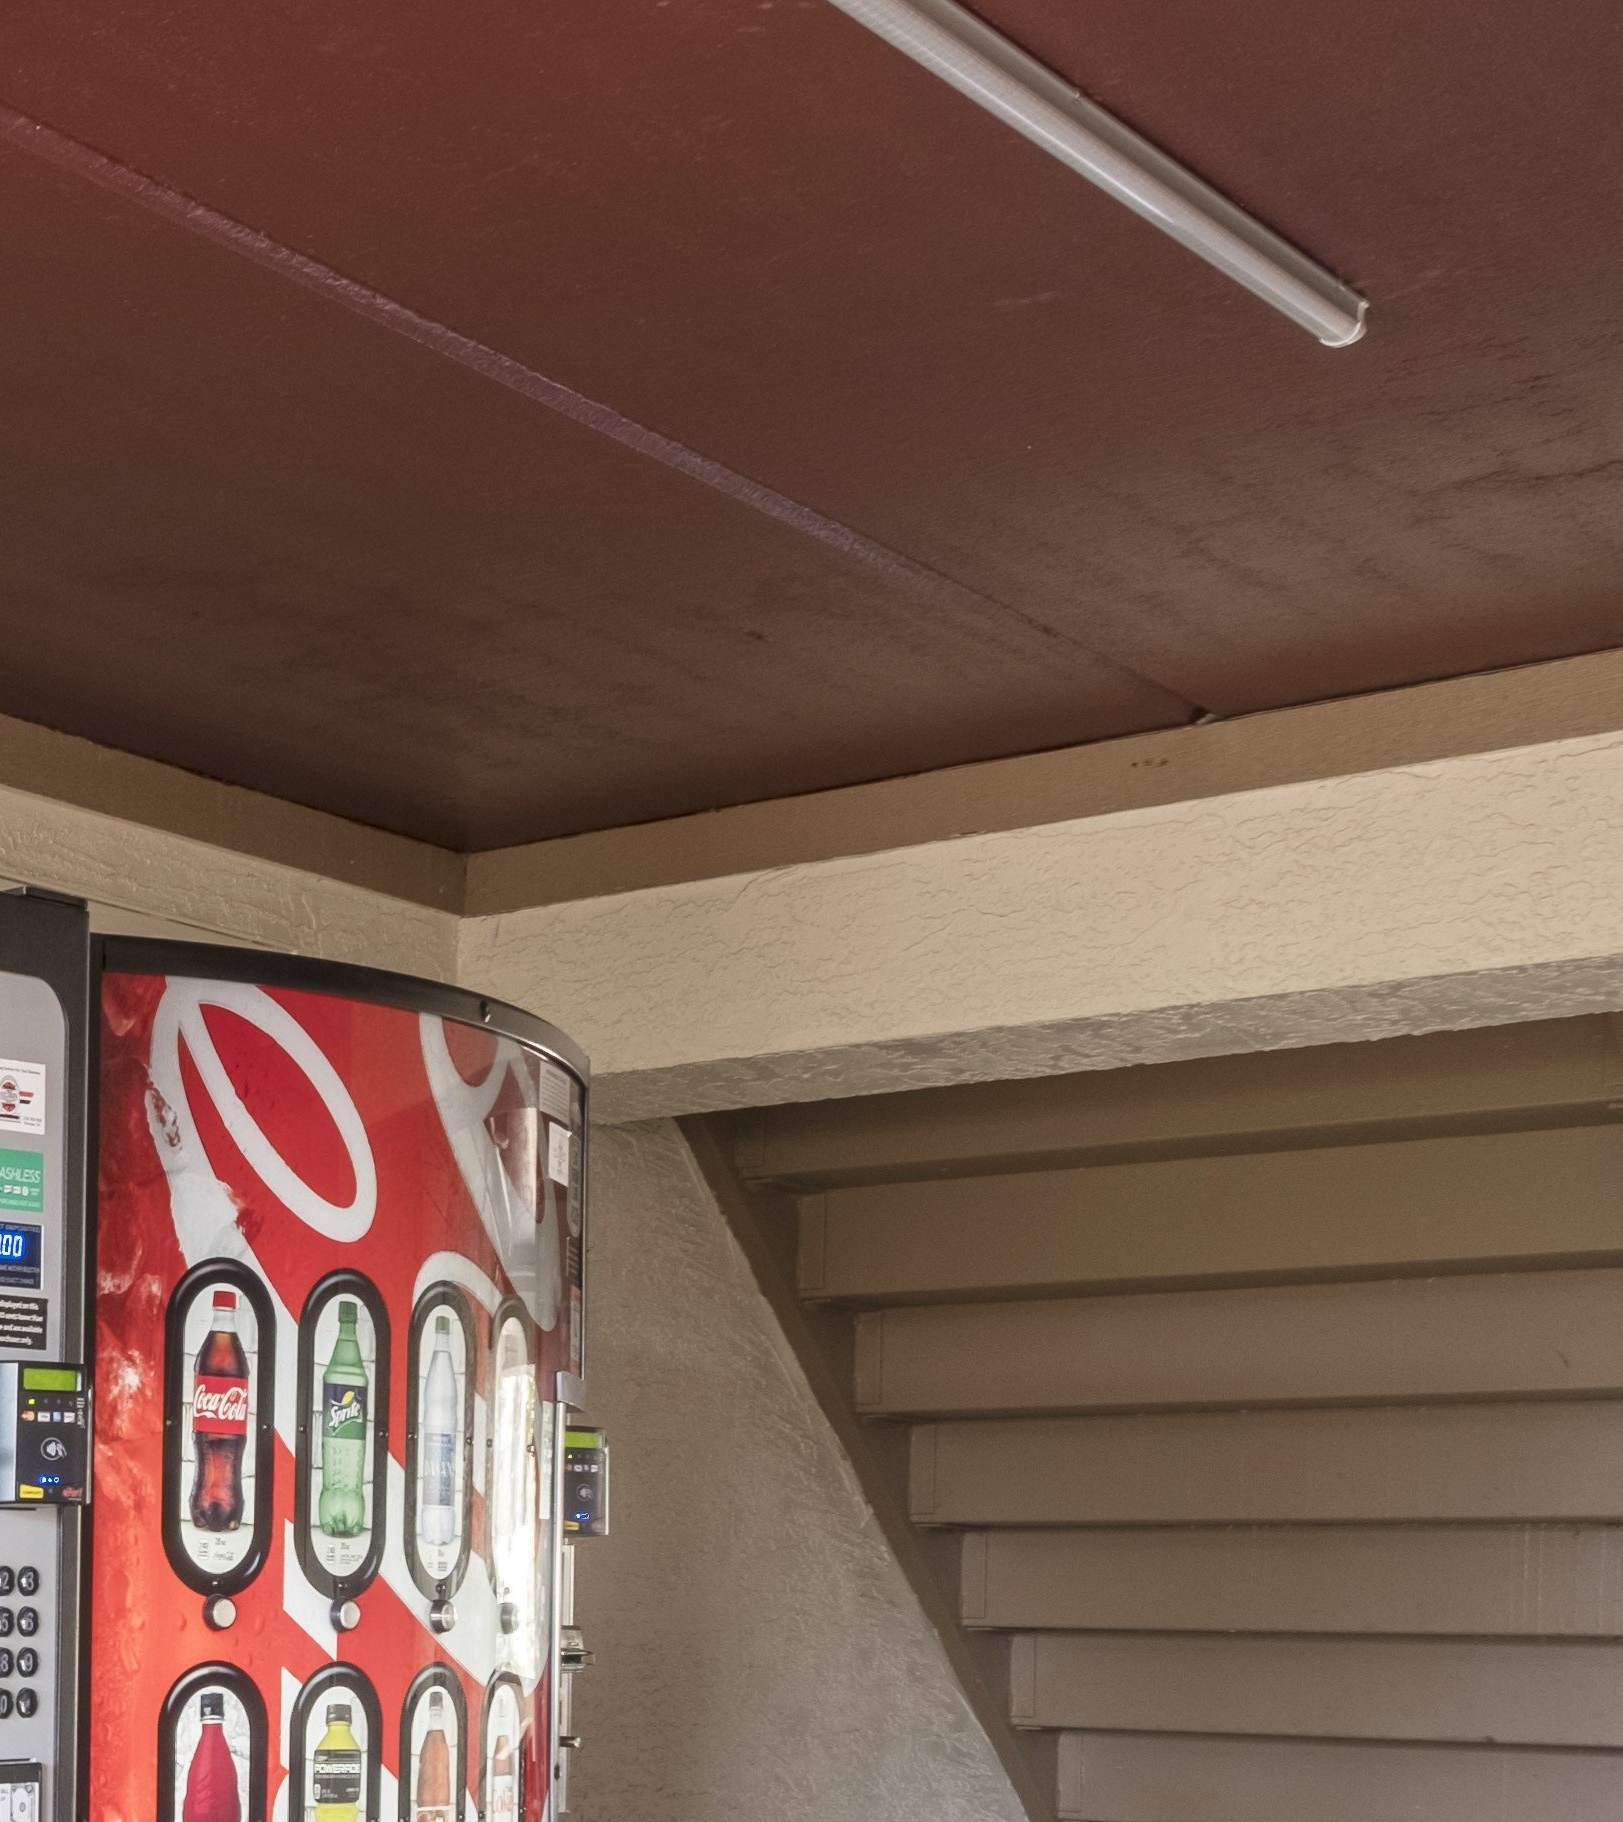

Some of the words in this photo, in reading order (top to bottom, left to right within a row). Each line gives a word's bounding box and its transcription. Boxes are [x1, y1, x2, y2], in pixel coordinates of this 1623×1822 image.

[194, 1384, 247, 1421] Coca-Cola
[328, 1401, 362, 1429] Sprite
[314, 1763, 361, 1774] POWERADE
